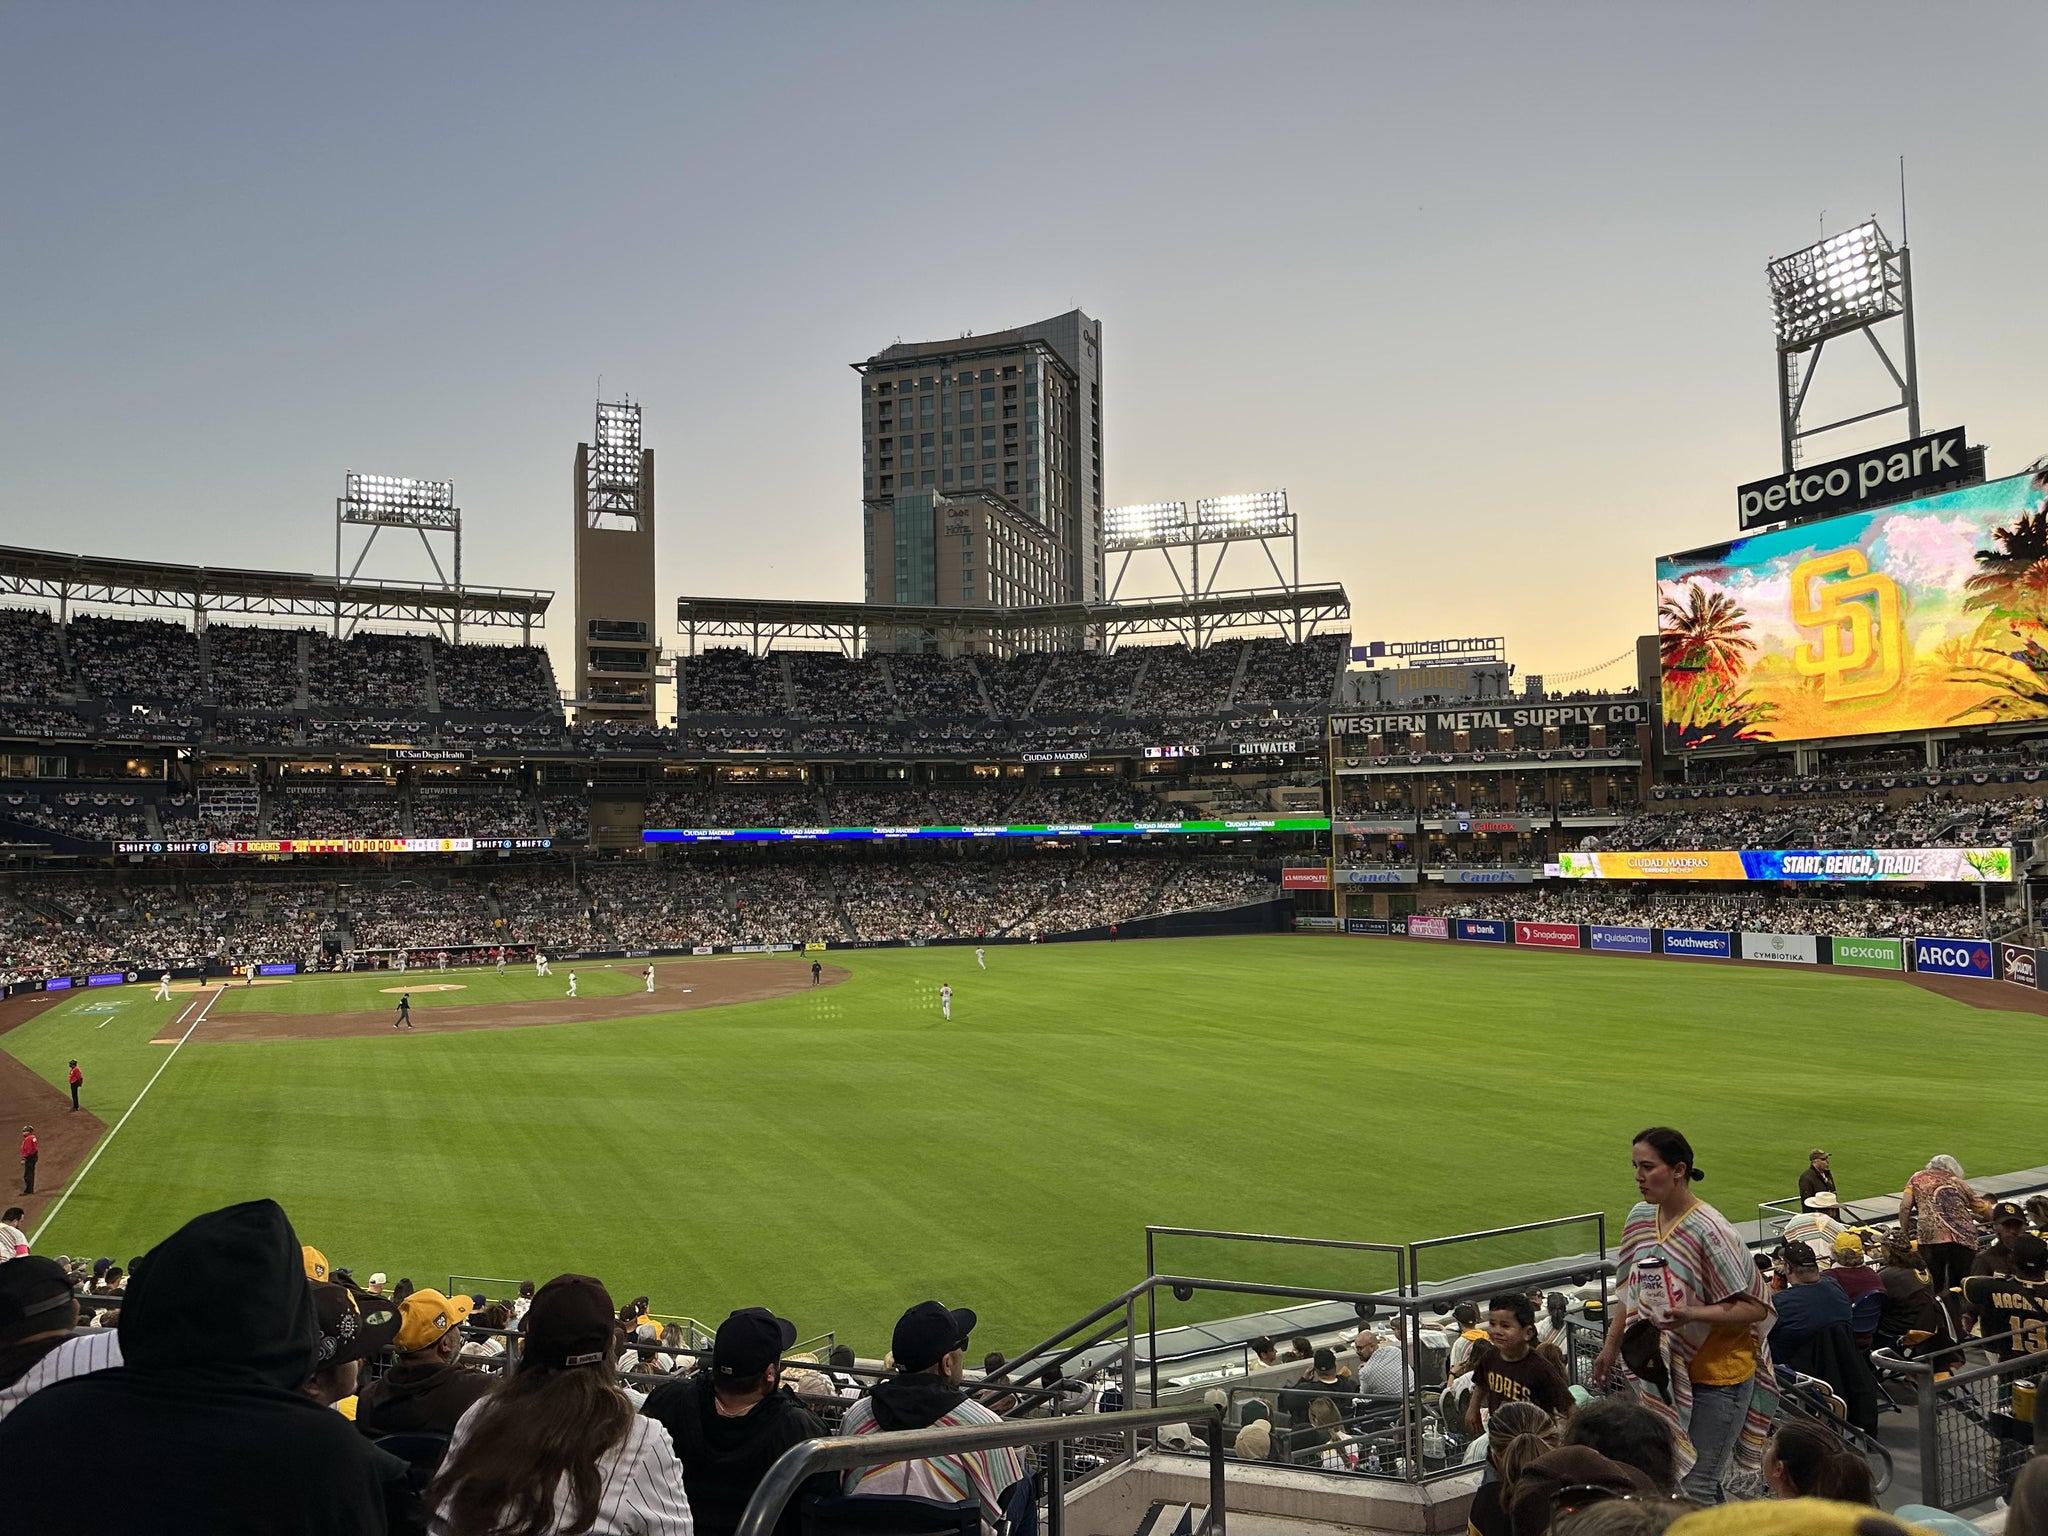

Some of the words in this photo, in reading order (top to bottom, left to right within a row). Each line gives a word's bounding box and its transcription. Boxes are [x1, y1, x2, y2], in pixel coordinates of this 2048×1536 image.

[1740, 468, 1851, 527] petco
[1858, 438, 1960, 499] park
[1391, 638, 1496, 656] QuidelOrtho
[1397, 669, 1468, 694] PADRES
[1332, 715, 1426, 734] WESTERN
[1437, 711, 1508, 730] METAL
[1514, 706, 1598, 727] SUPPLY
[1608, 705, 1646, 723] CO.
[1239, 742, 1296, 754] CUTWATER
[396, 750, 408, 758] UC
[408, 750, 421, 758] San
[422, 750, 442, 760] Diego
[443, 750, 465, 758] Health
[1023, 753, 1052, 762] CIUDAD
[1054, 751, 1088, 760] MADERAS
[420, 787, 458, 795] CUTWATER
[1852, 790, 1889, 798] LANDING
[1472, 821, 1515, 831] Calimax
[237, 843, 243, 851] 2
[246, 842, 280, 851] BOGAERTS
[1627, 858, 1664, 867] CIUDAD
[1666, 857, 1708, 867] MADERAS
[1782, 856, 1823, 875] START,
[1825, 855, 1874, 875] BENCH,
[1877, 855, 1923, 874] TRADE
[1349, 871, 1401, 882] Canel's
[1460, 871, 1516, 882] Canel's
[1391, 923, 1406, 933] 342
[1411, 926, 1446, 935] CALIFORNIA
[1466, 925, 1476, 934] us
[1476, 925, 1495, 935] bank
[1533, 929, 1575, 942] Snapdragon
[1604, 933, 1648, 944] QuidelOrtho
[1667, 936, 1719, 949] Southwest
[1753, 952, 1804, 961] CYMBIOTIKA
[1918, 946, 1970, 967] ARCO
[2005, 948, 2033, 981] Sycuan
[2009, 1315, 2048, 1353] 13
[1488, 1371, 1532, 1402] ADRES
